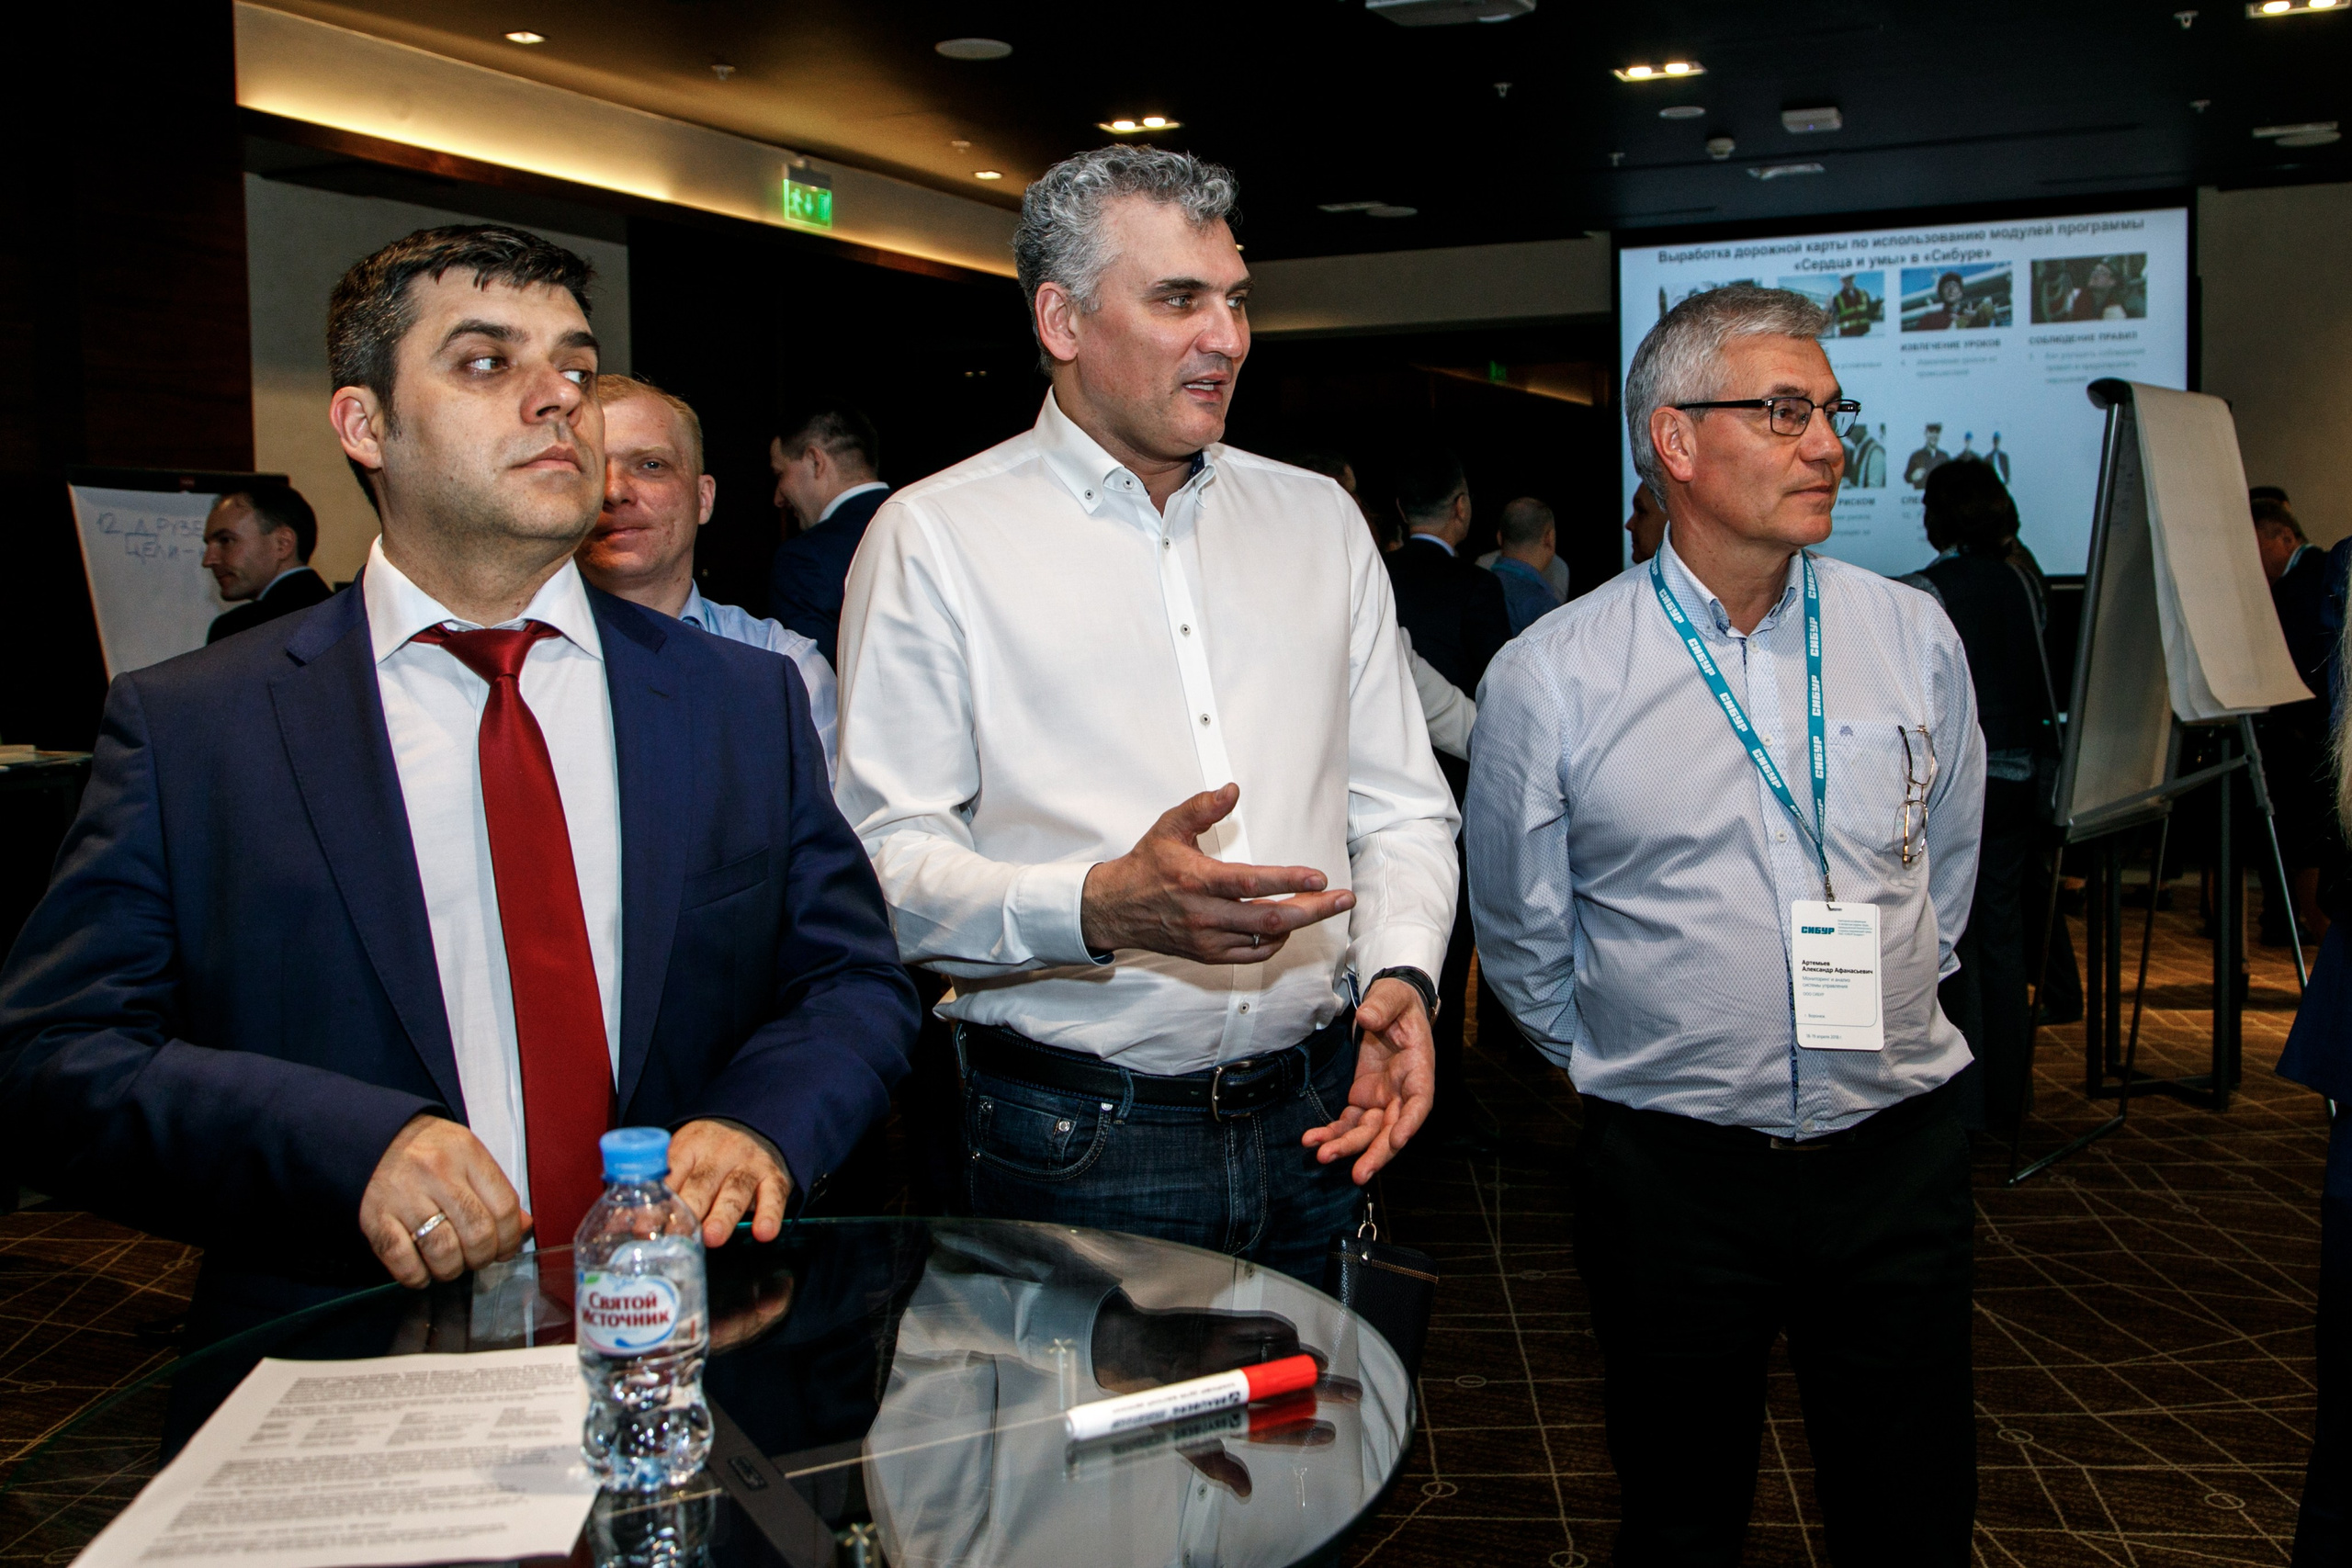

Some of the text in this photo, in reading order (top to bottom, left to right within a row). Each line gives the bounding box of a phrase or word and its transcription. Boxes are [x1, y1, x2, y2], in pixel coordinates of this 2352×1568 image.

[1658, 219, 2144, 264] Выработка дорожной карты по использованию модулей программы
[1794, 257, 1852, 273] «Сердца
[1856, 255, 1865, 267] и
[1911, 253, 1919, 264] в
[1924, 248, 1992, 264] «Сибуре»
[1658, 588, 1685, 624] СИБУР
[1687, 637, 1715, 677] СИБУР
[1810, 616, 1820, 658] СИБУР
[1719, 692, 1748, 733] СИБУР
[1812, 674, 1822, 716] СИБУР
[1751, 748, 1782, 790] СИБУР
[1815, 736, 1826, 780] СИБУР
[1801, 926, 1835, 934] СИБУР
[1802, 976, 1830, 984] Мониторинг
[1834, 967, 1873, 976] Афанасьевич
